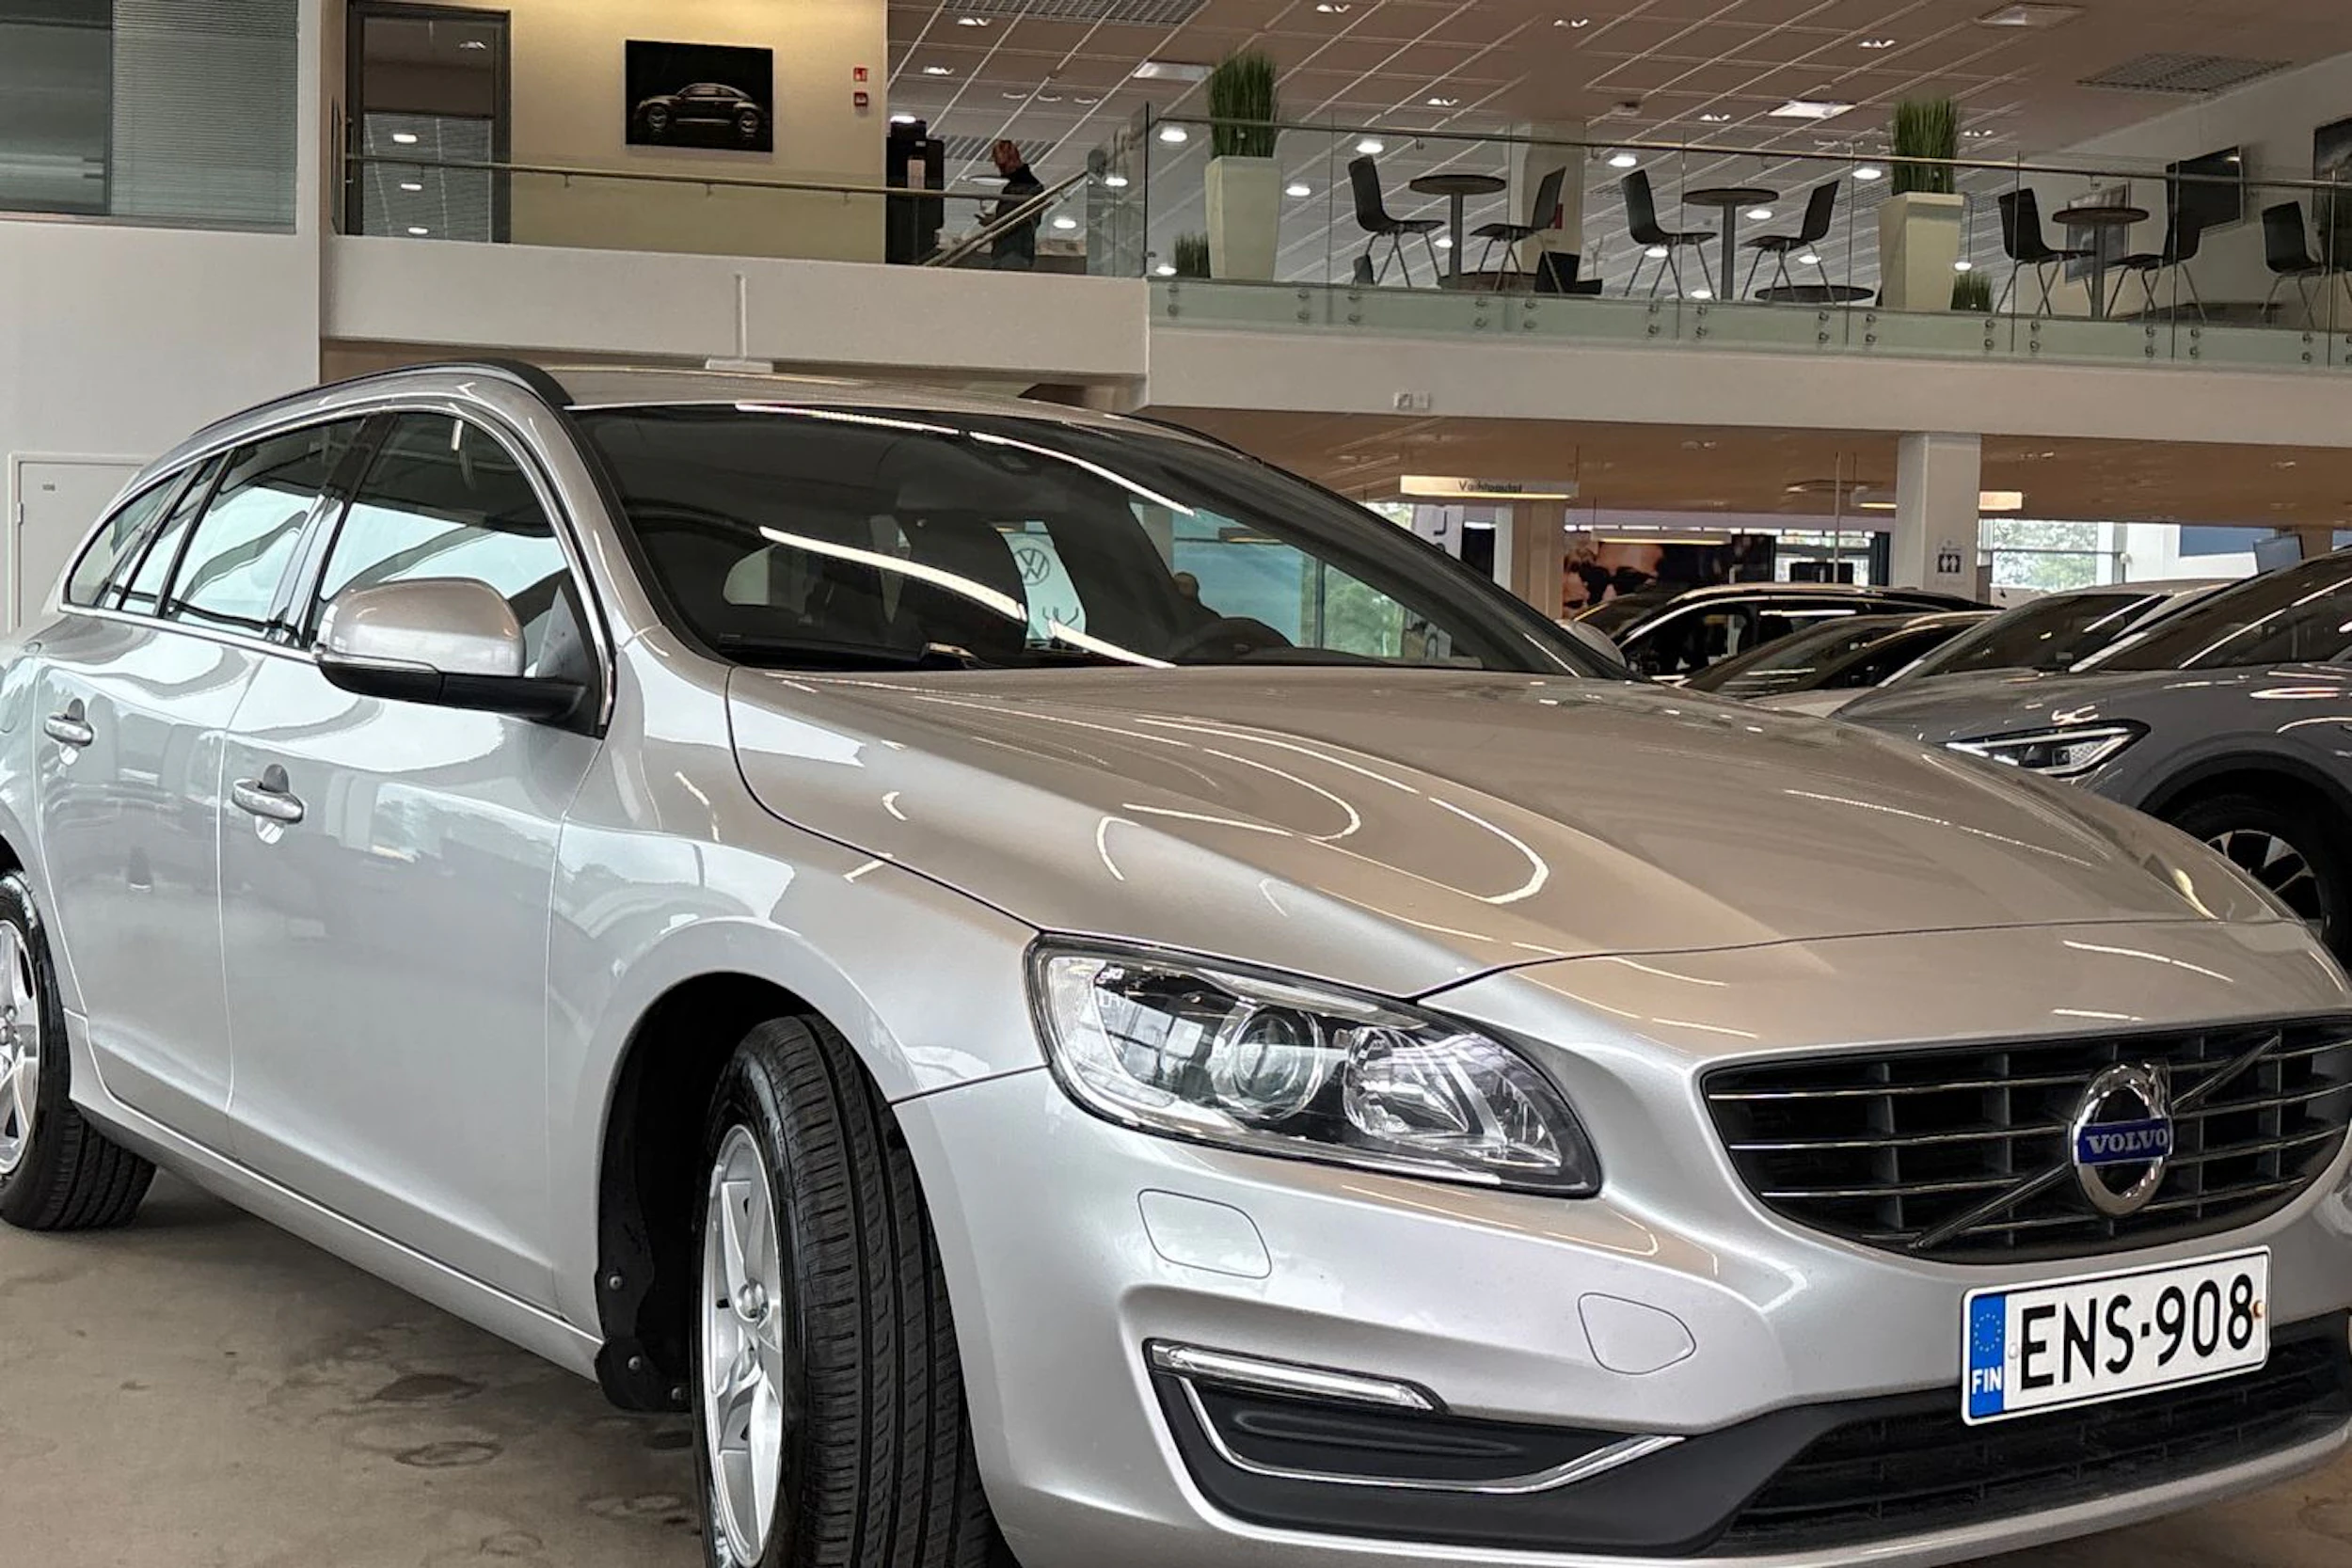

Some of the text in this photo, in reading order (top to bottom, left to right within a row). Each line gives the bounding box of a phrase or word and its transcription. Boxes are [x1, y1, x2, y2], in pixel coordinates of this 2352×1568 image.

[2086, 1127, 2169, 1155] VOLVO
[2020, 1273, 2253, 1392] ENS-908
[1972, 1366, 2002, 1395] FIN
